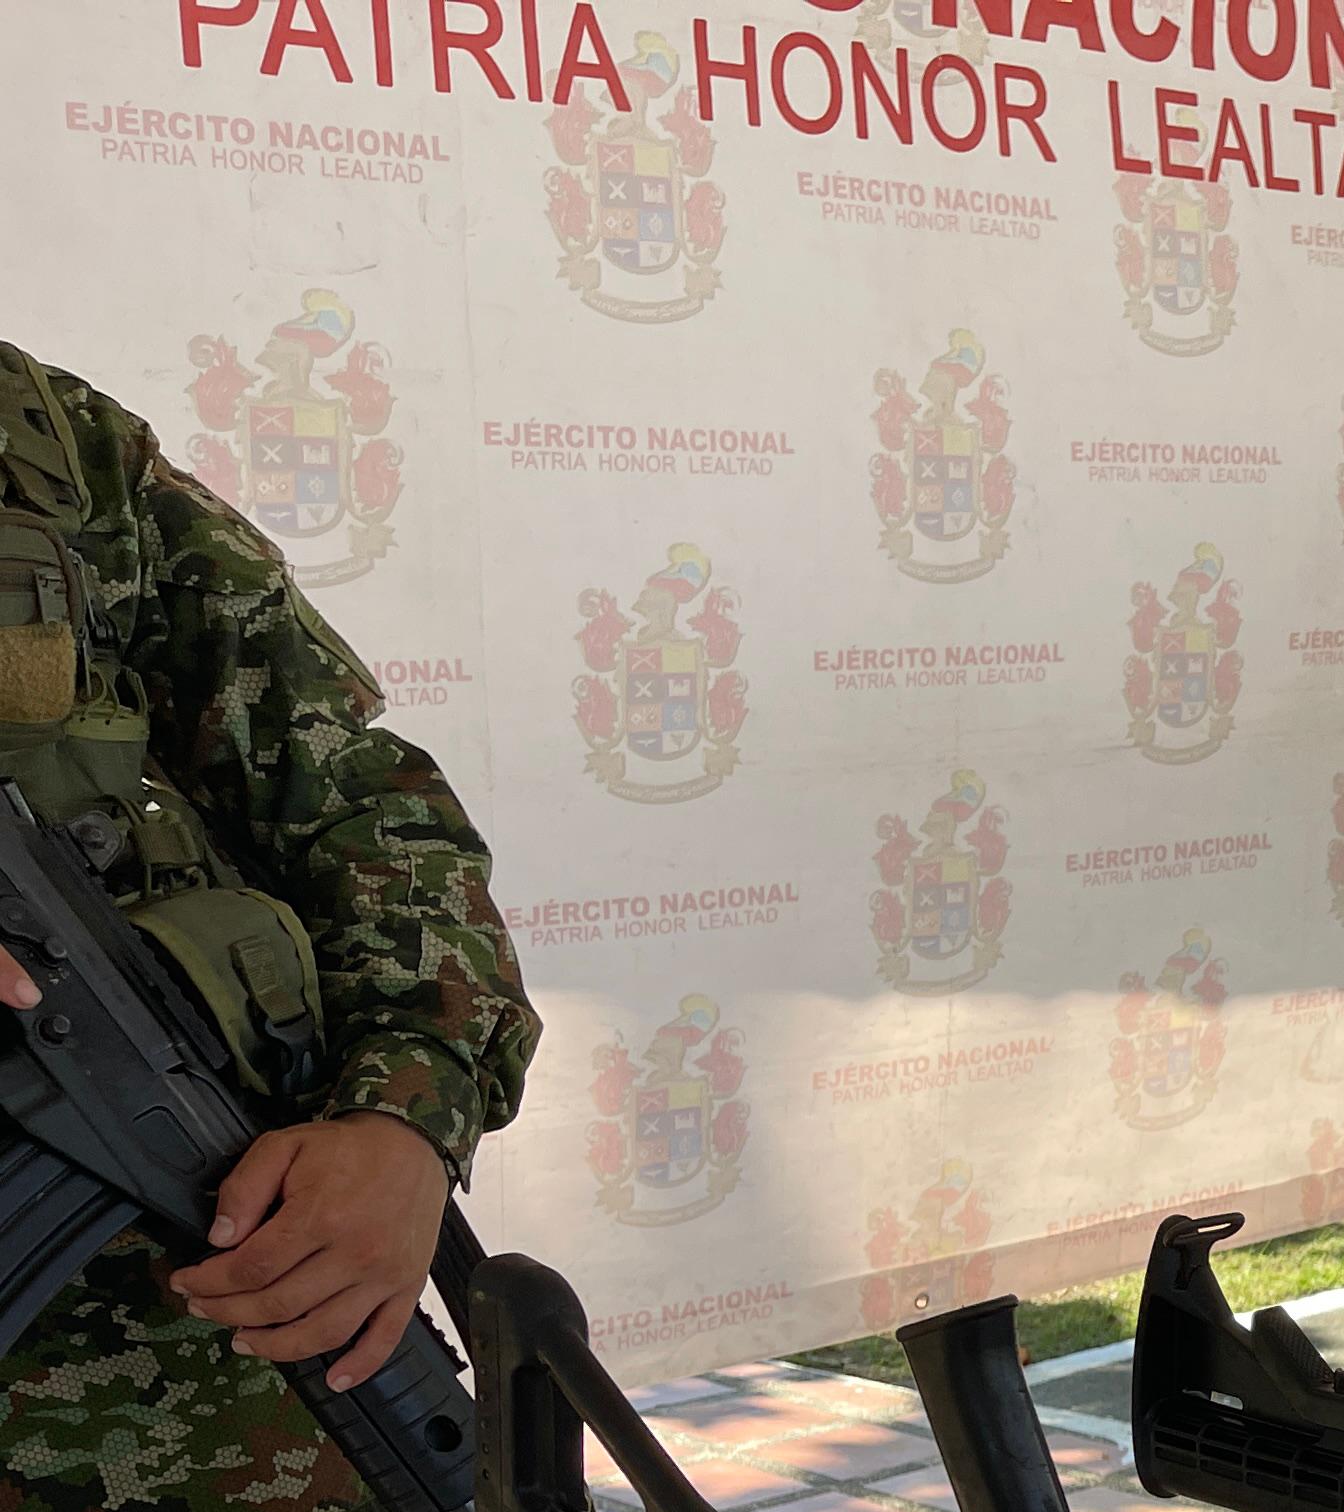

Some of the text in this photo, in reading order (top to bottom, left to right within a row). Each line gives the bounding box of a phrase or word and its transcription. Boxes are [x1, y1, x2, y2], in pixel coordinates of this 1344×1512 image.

[693, 19, 1057, 163] HONOR
[65, 101, 450, 161] EJÉRCITO NACIONAL
[101, 139, 424, 184] PATRIA HONOR LEALTAD
[797, 170, 1058, 221] EJÉRCITO NACIONAL
[821, 201, 1041, 240] PATRIA HONOR LEALTAD
[482, 417, 795, 454] EJÉRCITO NACIONAL
[1071, 438, 1283, 465] EJÉRCITO NACIONAL
[511, 451, 774, 476] PATRIA HONOR LEALTAD
[1088, 466, 1267, 484] PATRIA HONOR LEALTAD
[373, 657, 473, 685] IONAL
[813, 642, 1064, 671] EJÉRCITO NACIONAL
[835, 666, 1046, 690] PATRIA HONOR LEALTAD
[1066, 832, 1272, 872] EJÉRCITO NACIONAL
[1082, 854, 1257, 888] PATRIA HONOR LEALTAD
[504, 882, 800, 929] EJÉRCITO NACIONAL
[531, 907, 779, 947] PATRIA HONOR LEALTAD
[812, 1036, 1052, 1090] EJÉRCITO NACIONAL
[832, 1058, 1034, 1104] PATRIA HONOR LEALTAD
[661, 1281, 795, 1325] NACIONAL
[618, 1322, 687, 1350] HONOR
[697, 1303, 775, 1332] LEALTAD
